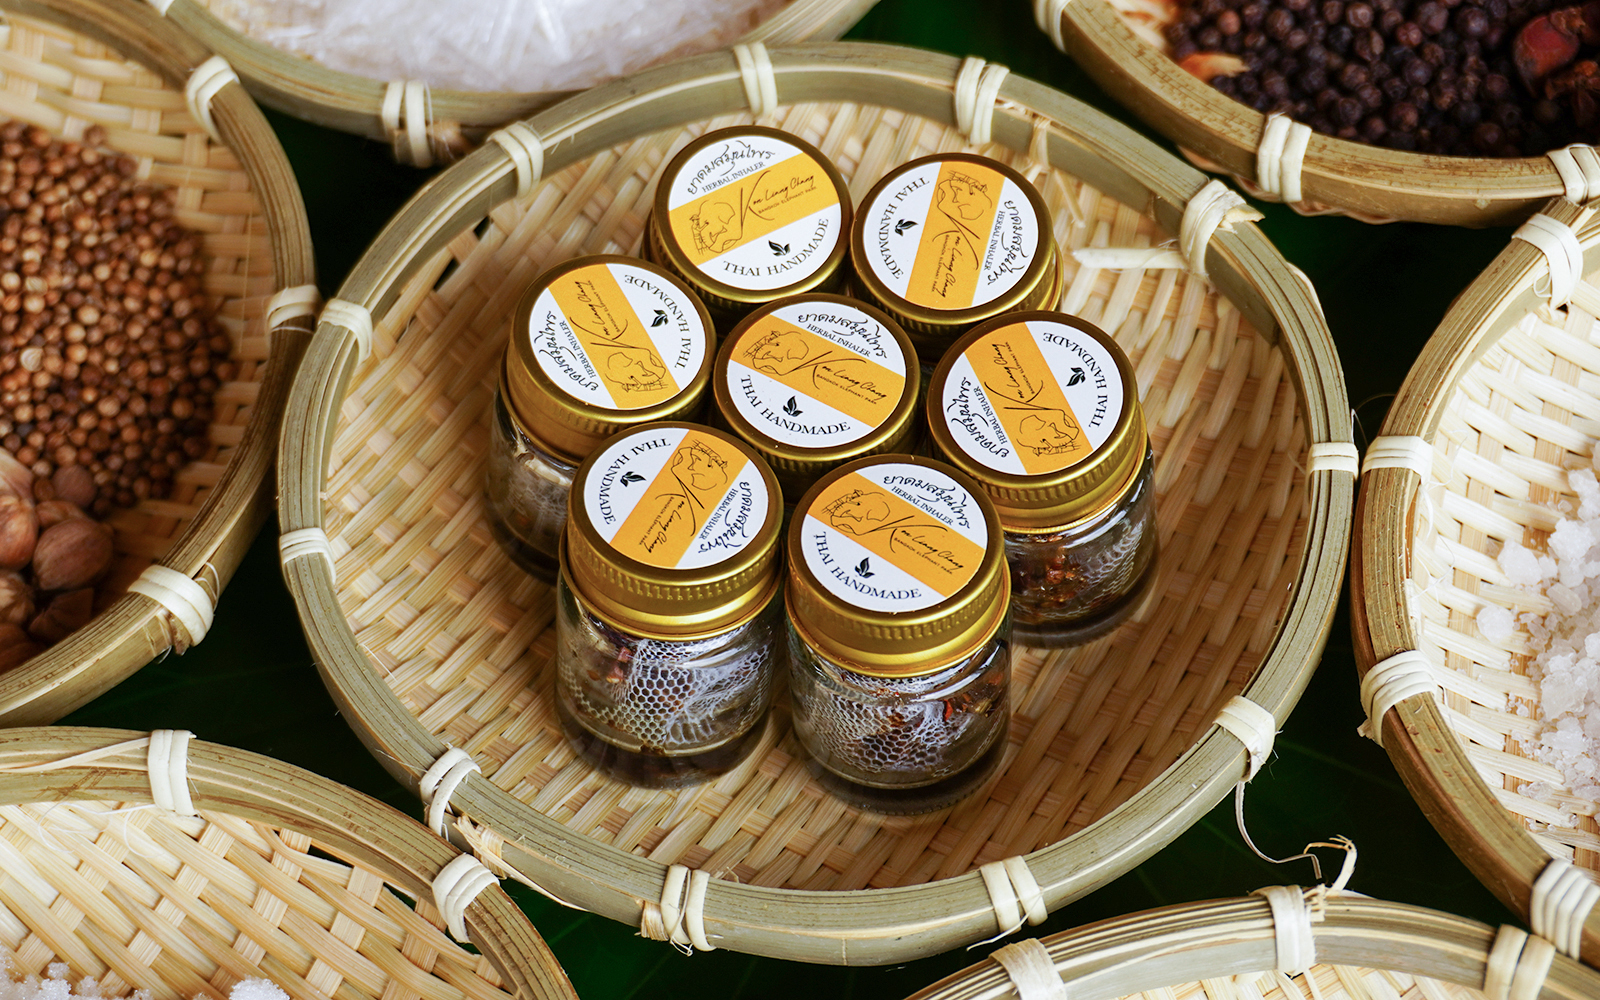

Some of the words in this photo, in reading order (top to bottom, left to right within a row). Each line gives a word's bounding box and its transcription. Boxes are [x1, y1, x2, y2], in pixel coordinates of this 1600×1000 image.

[702, 177, 733, 193] HERBAL
[733, 162, 765, 180] INHALER
[790, 175, 814, 190] Chang
[894, 177, 930, 202] THAI
[758, 203, 779, 214] BANGKOK
[781, 192, 804, 205] ELEPHANT
[994, 210, 1005, 238] HERBAL
[723, 261, 761, 276] THAI
[767, 218, 829, 275] HANDMADE
[878, 203, 905, 279] HANDMADE
[940, 235, 949, 255] BANGKOK
[984, 238, 997, 270] INHALER
[935, 256, 944, 278] ELEPHANT
[575, 281, 591, 302] Chang
[936, 272, 956, 297] Chang
[595, 293, 609, 313] ELEPHANT
[624, 274, 690, 333] HANDMADE
[559, 320, 580, 351] INHALER
[606, 314, 621, 332] BANGKOK
[675, 338, 691, 369] THAI
[807, 324, 837, 341] HERBAL
[837, 337, 870, 357] INHALER
[578, 351, 596, 378] HERBAL
[992, 344, 1007, 365] Chang
[1011, 353, 1025, 373] ELEPHANT
[1043, 332, 1107, 389] HANDMADE
[816, 374, 838, 386] BANGKOK
[840, 385, 863, 398] ELEPHANT
[860, 382, 887, 400] Chang
[1021, 375, 1035, 394] BANGKOK
[741, 375, 762, 408] THAI
[760, 408, 851, 434] HANDMADE
[973, 386, 992, 417] INHALER
[1089, 395, 1107, 428] THAI
[991, 414, 1007, 444] HERBAL
[631, 439, 671, 455] THAI
[599, 455, 630, 524] HANDMADE
[718, 488, 738, 514] HERBAL
[660, 497, 674, 515] BANGKOK
[891, 486, 921, 506] HERBAL
[920, 503, 954, 525] INHALER
[648, 515, 662, 534] ELEPHANT
[699, 512, 721, 539] INHALER
[646, 534, 667, 553] Chang
[893, 537, 915, 552] BANGKOK
[916, 551, 940, 567] ELEPHANT
[814, 531, 834, 565] THAI
[831, 566, 922, 599] HANDMADE
[937, 550, 963, 570] Chang
